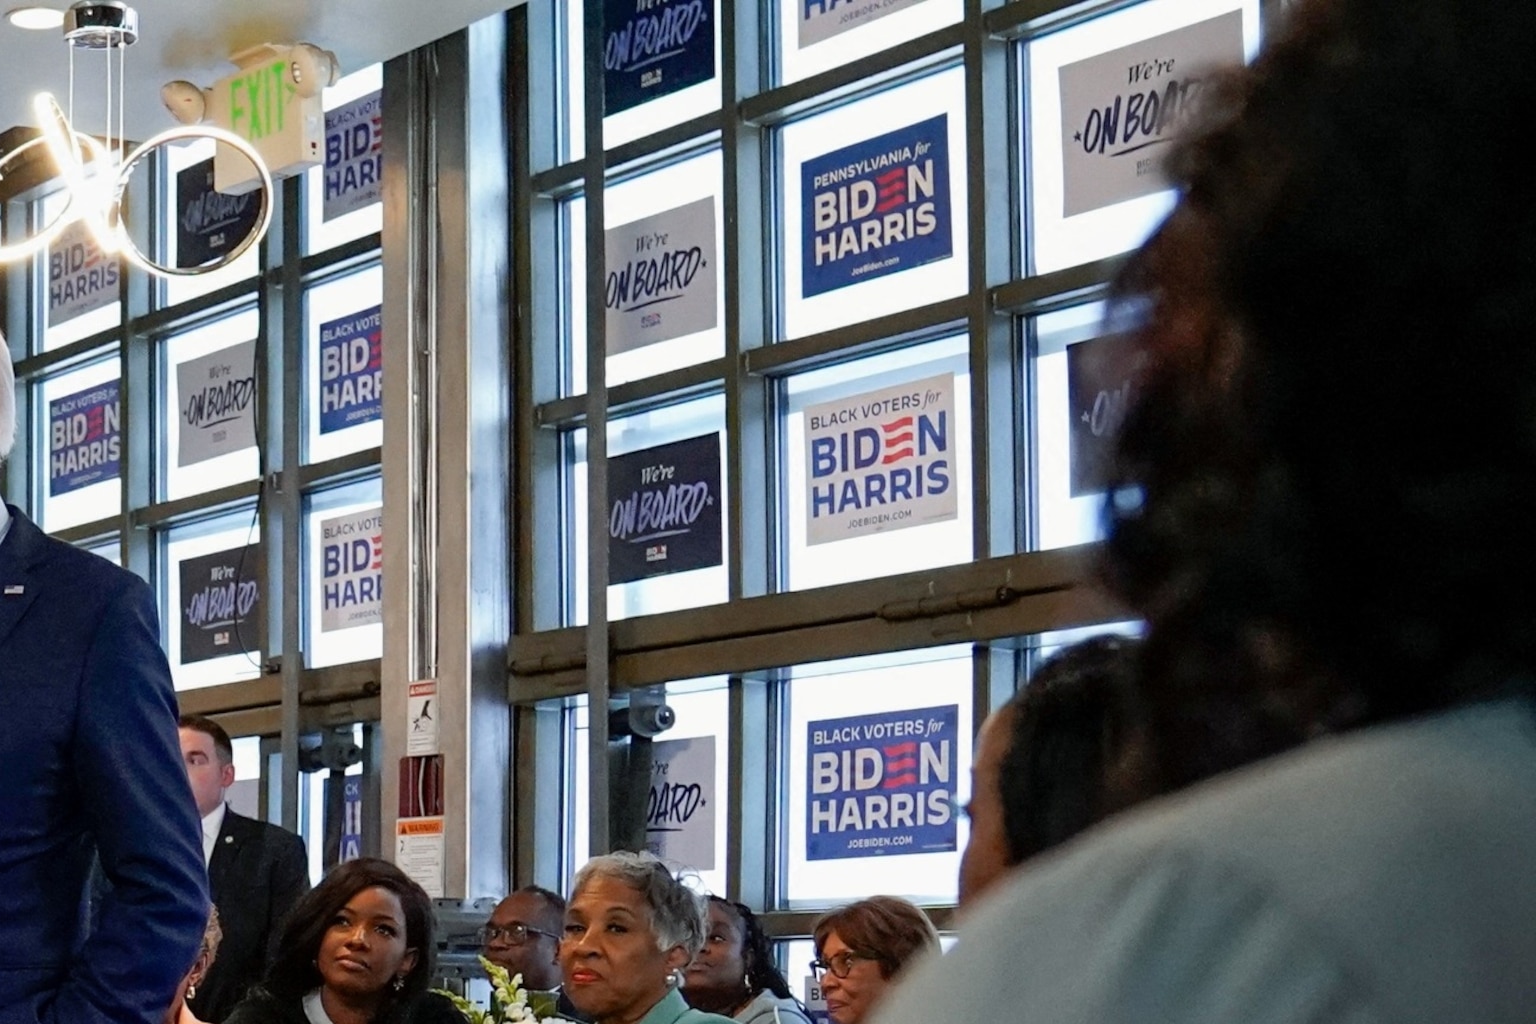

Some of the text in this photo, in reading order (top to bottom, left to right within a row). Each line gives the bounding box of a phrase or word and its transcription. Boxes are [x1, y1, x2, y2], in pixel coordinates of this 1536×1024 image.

[605, 0, 702, 70] ON BOARD
[1127, 58, 1175, 86] We're
[231, 61, 285, 141] EXIT
[1084, 95, 1121, 154] ON
[814, 141, 931, 190] PENNSYLVANIA for
[814, 159, 934, 232] BIDEN
[815, 202, 936, 266] HARRIS
[51, 261, 118, 309] HARRIS
[605, 246, 701, 309] ON BOARD
[323, 322, 355, 342] BLACK
[187, 377, 255, 426] ON BOARD
[811, 389, 941, 430] BLACK VOTERS for
[52, 401, 120, 451] BIDEN
[812, 410, 947, 478] BIDEN
[52, 435, 120, 479] HARRIS
[641, 464, 675, 485] We're
[610, 481, 708, 540] ON BOARD
[812, 460, 949, 518] HARRIS
[324, 523, 355, 539] BLACK
[848, 510, 912, 529] JOEBIDEN.COM
[189, 581, 256, 626] ON BOARD
[814, 718, 944, 745] BLACK VOTERS for
[813, 740, 950, 794] BIDEN
[647, 782, 701, 825] OARD
[812, 788, 950, 834] HARRIS
[848, 836, 913, 849] JOEBIDEN.COM
